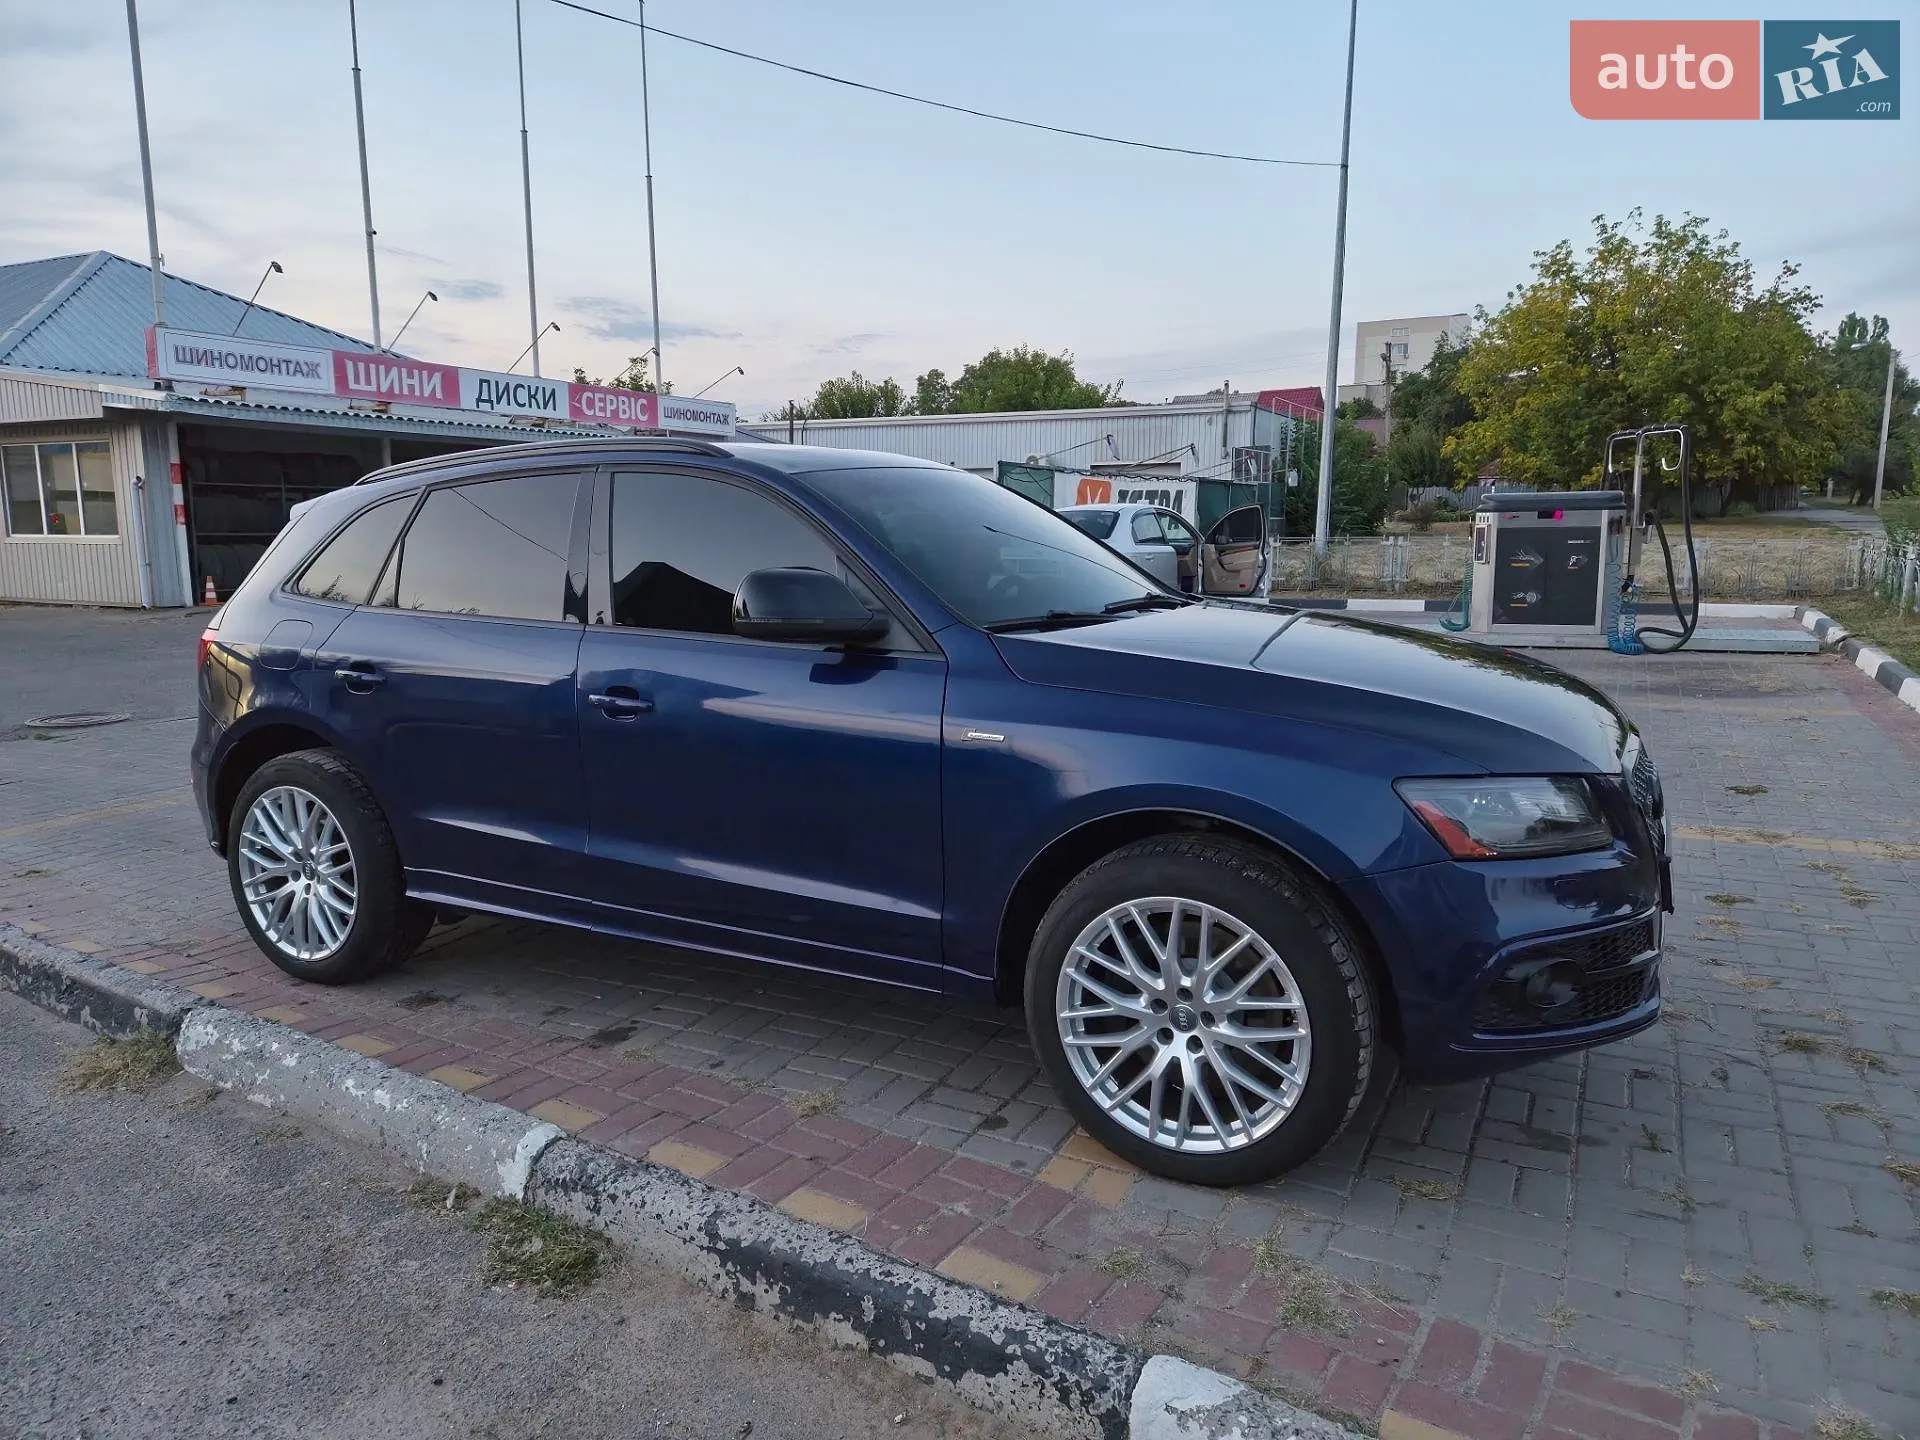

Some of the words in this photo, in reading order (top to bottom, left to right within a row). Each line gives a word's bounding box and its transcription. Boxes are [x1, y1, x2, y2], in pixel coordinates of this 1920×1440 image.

[173, 343, 322, 380] ШИНОМОНТАЖ
[345, 358, 444, 400] ШИНИ
[475, 378, 557, 412] ДИСКИ
[581, 391, 648, 422] СЕРВІС
[663, 406, 730, 426] ШИНОМОНТАЖ
